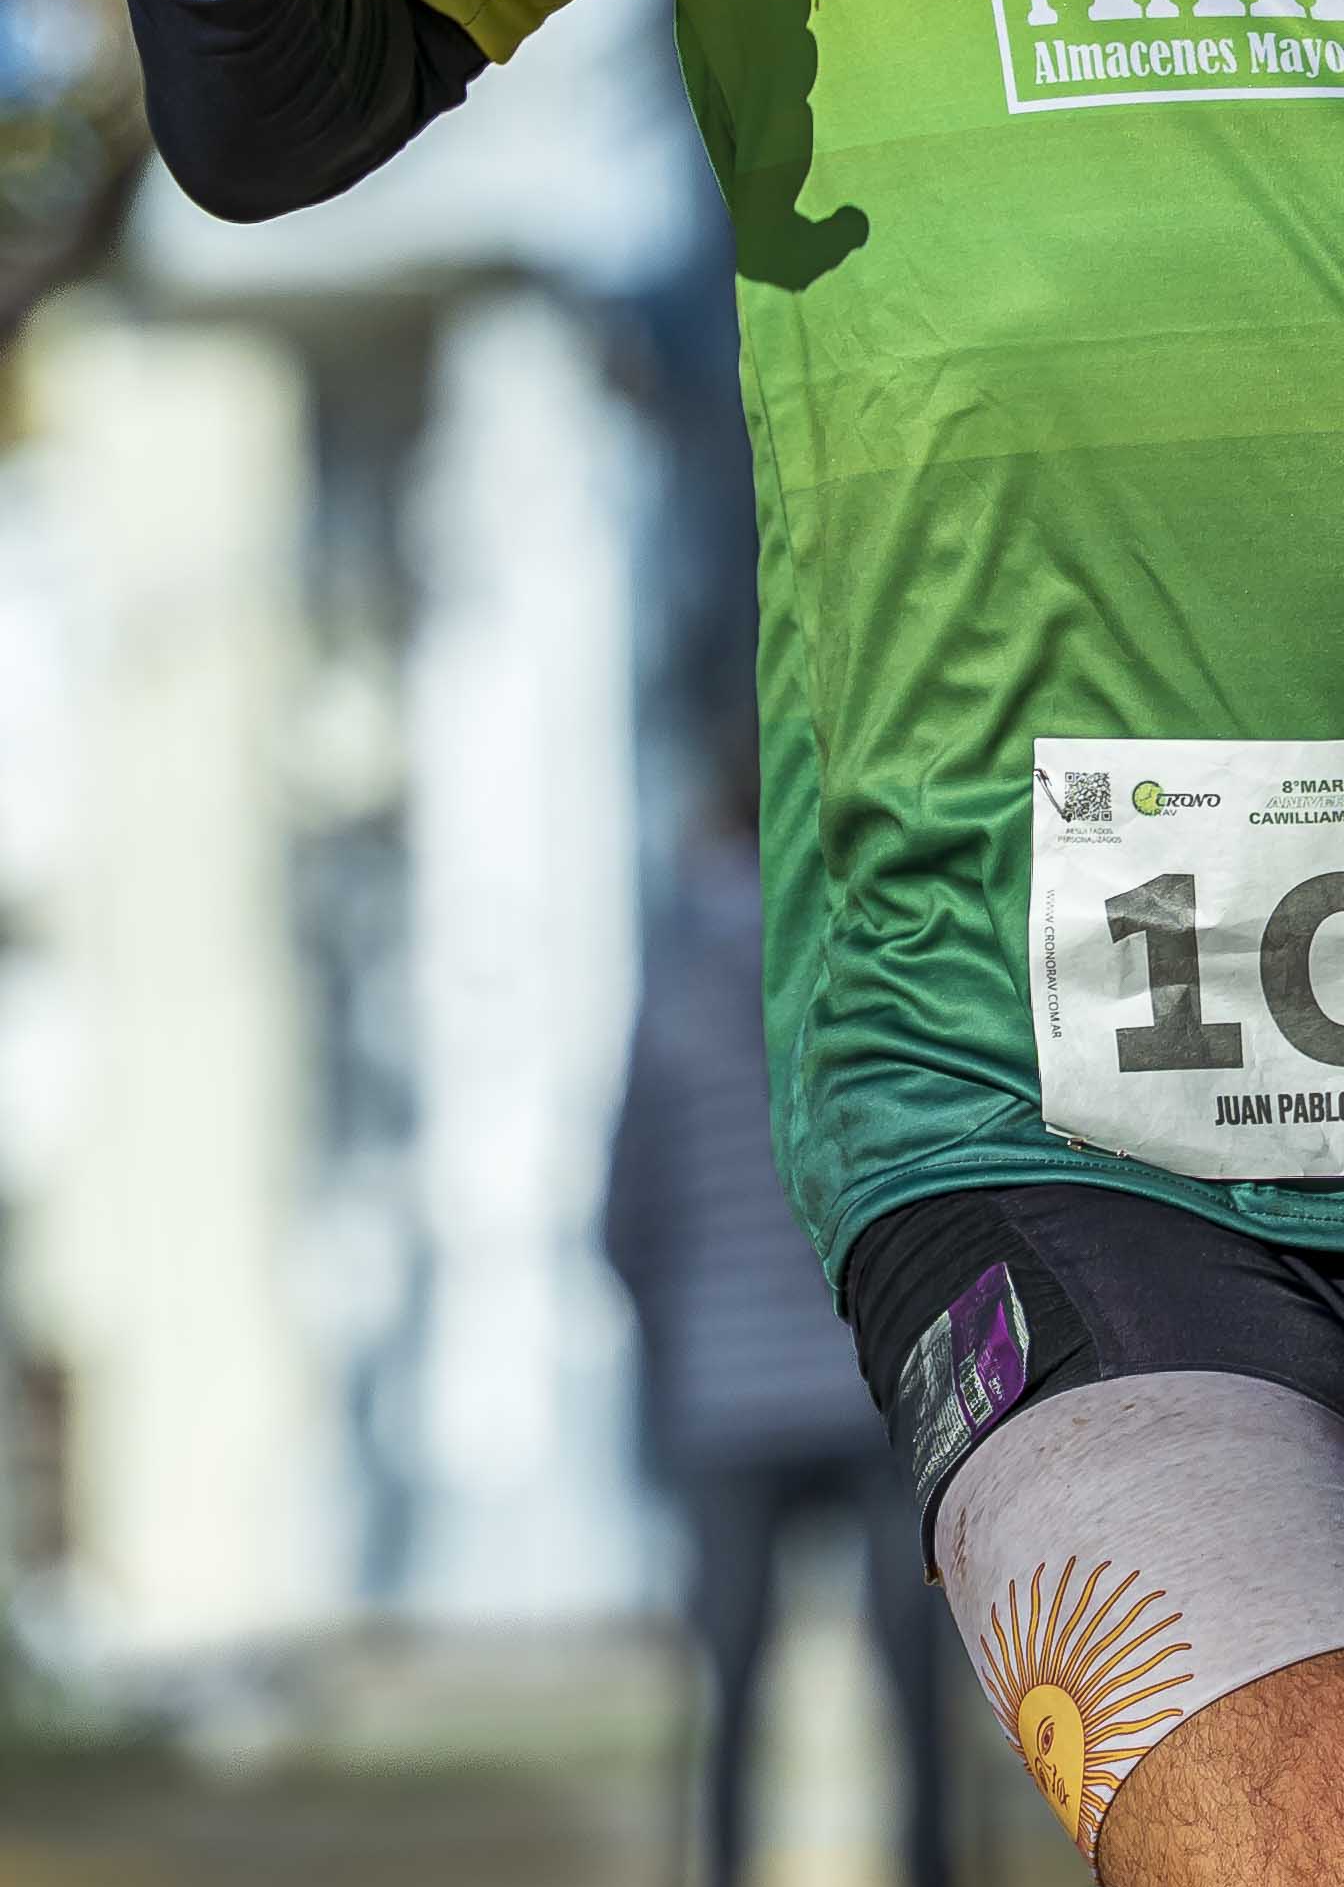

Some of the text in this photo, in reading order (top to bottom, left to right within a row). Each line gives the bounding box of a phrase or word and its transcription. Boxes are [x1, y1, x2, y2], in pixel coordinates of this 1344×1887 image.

[1033, 37, 1237, 85] Almacenes
[1156, 794, 1221, 807] CRONO
[1215, 1094, 1273, 1126] JUAN
